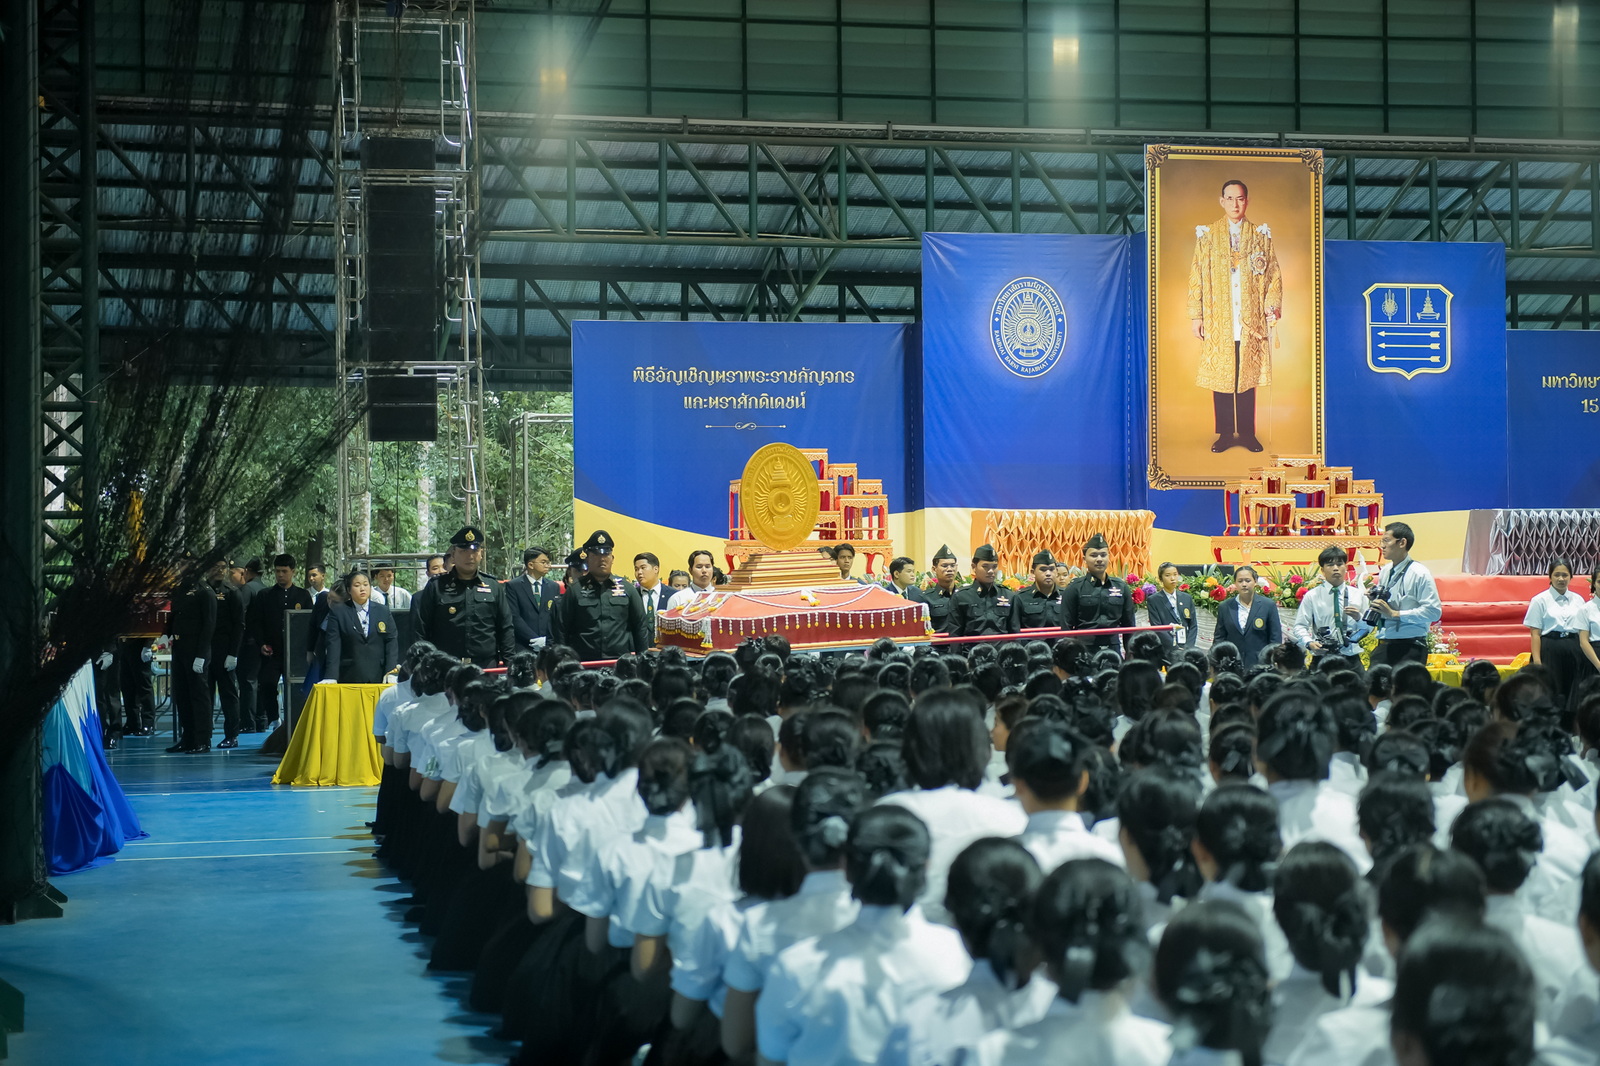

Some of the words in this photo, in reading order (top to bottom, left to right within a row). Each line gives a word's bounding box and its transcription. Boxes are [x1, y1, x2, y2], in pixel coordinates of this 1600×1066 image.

[1048, 331, 1063, 361] UNIVERSITY
[632, 365, 855, 386] พิธีอัญเชิญตราพระราชลัญจกร
[683, 391, 806, 409] และตราศักดิเดชน์
